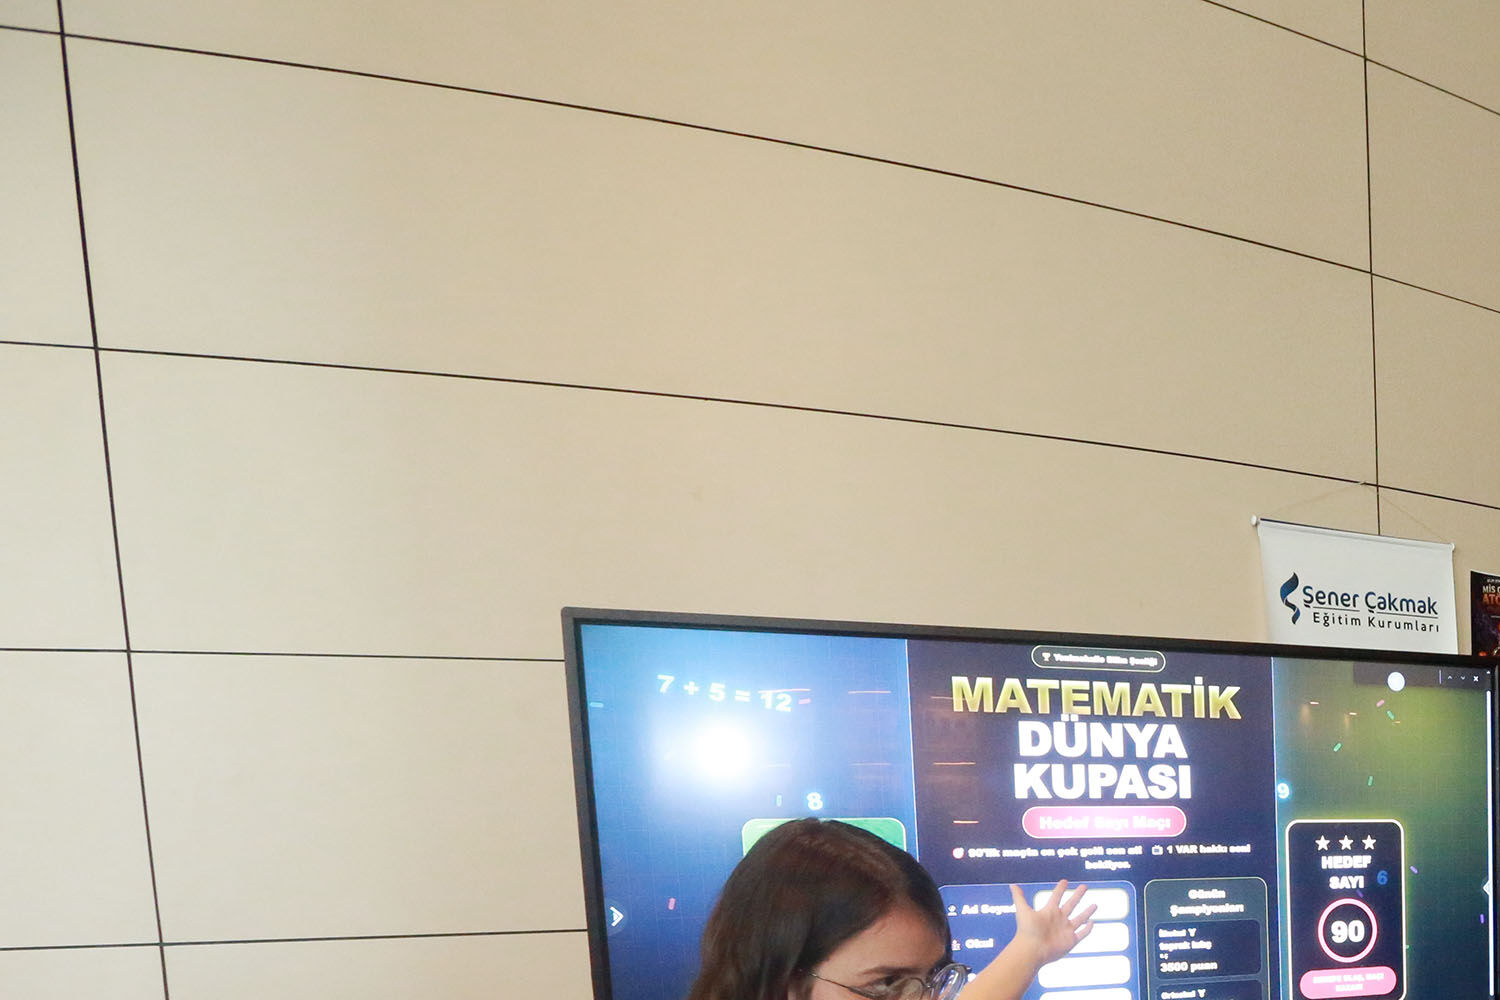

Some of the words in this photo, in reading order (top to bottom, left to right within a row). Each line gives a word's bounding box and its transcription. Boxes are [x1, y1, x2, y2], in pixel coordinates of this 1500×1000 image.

[1302, 585, 1360, 608] Şener
[1364, 591, 1438, 615] Çakmak
[1313, 611, 1361, 627] Eğitim
[1367, 616, 1440, 633] Kurumları
[657, 674, 675, 694] 7
[709, 683, 725, 702] 5
[760, 692, 792, 712] 12
[951, 676, 1242, 719] MATEMATİK
[1018, 713, 1188, 758] DÜNYA
[1013, 764, 1192, 799] KUPASI
[1277, 783, 1290, 798] 9
[806, 792, 823, 810] 8
[1321, 855, 1372, 869] HEDEF
[1329, 875, 1365, 890] SAYI
[1376, 870, 1389, 885] 6
[1330, 919, 1365, 944] 90
